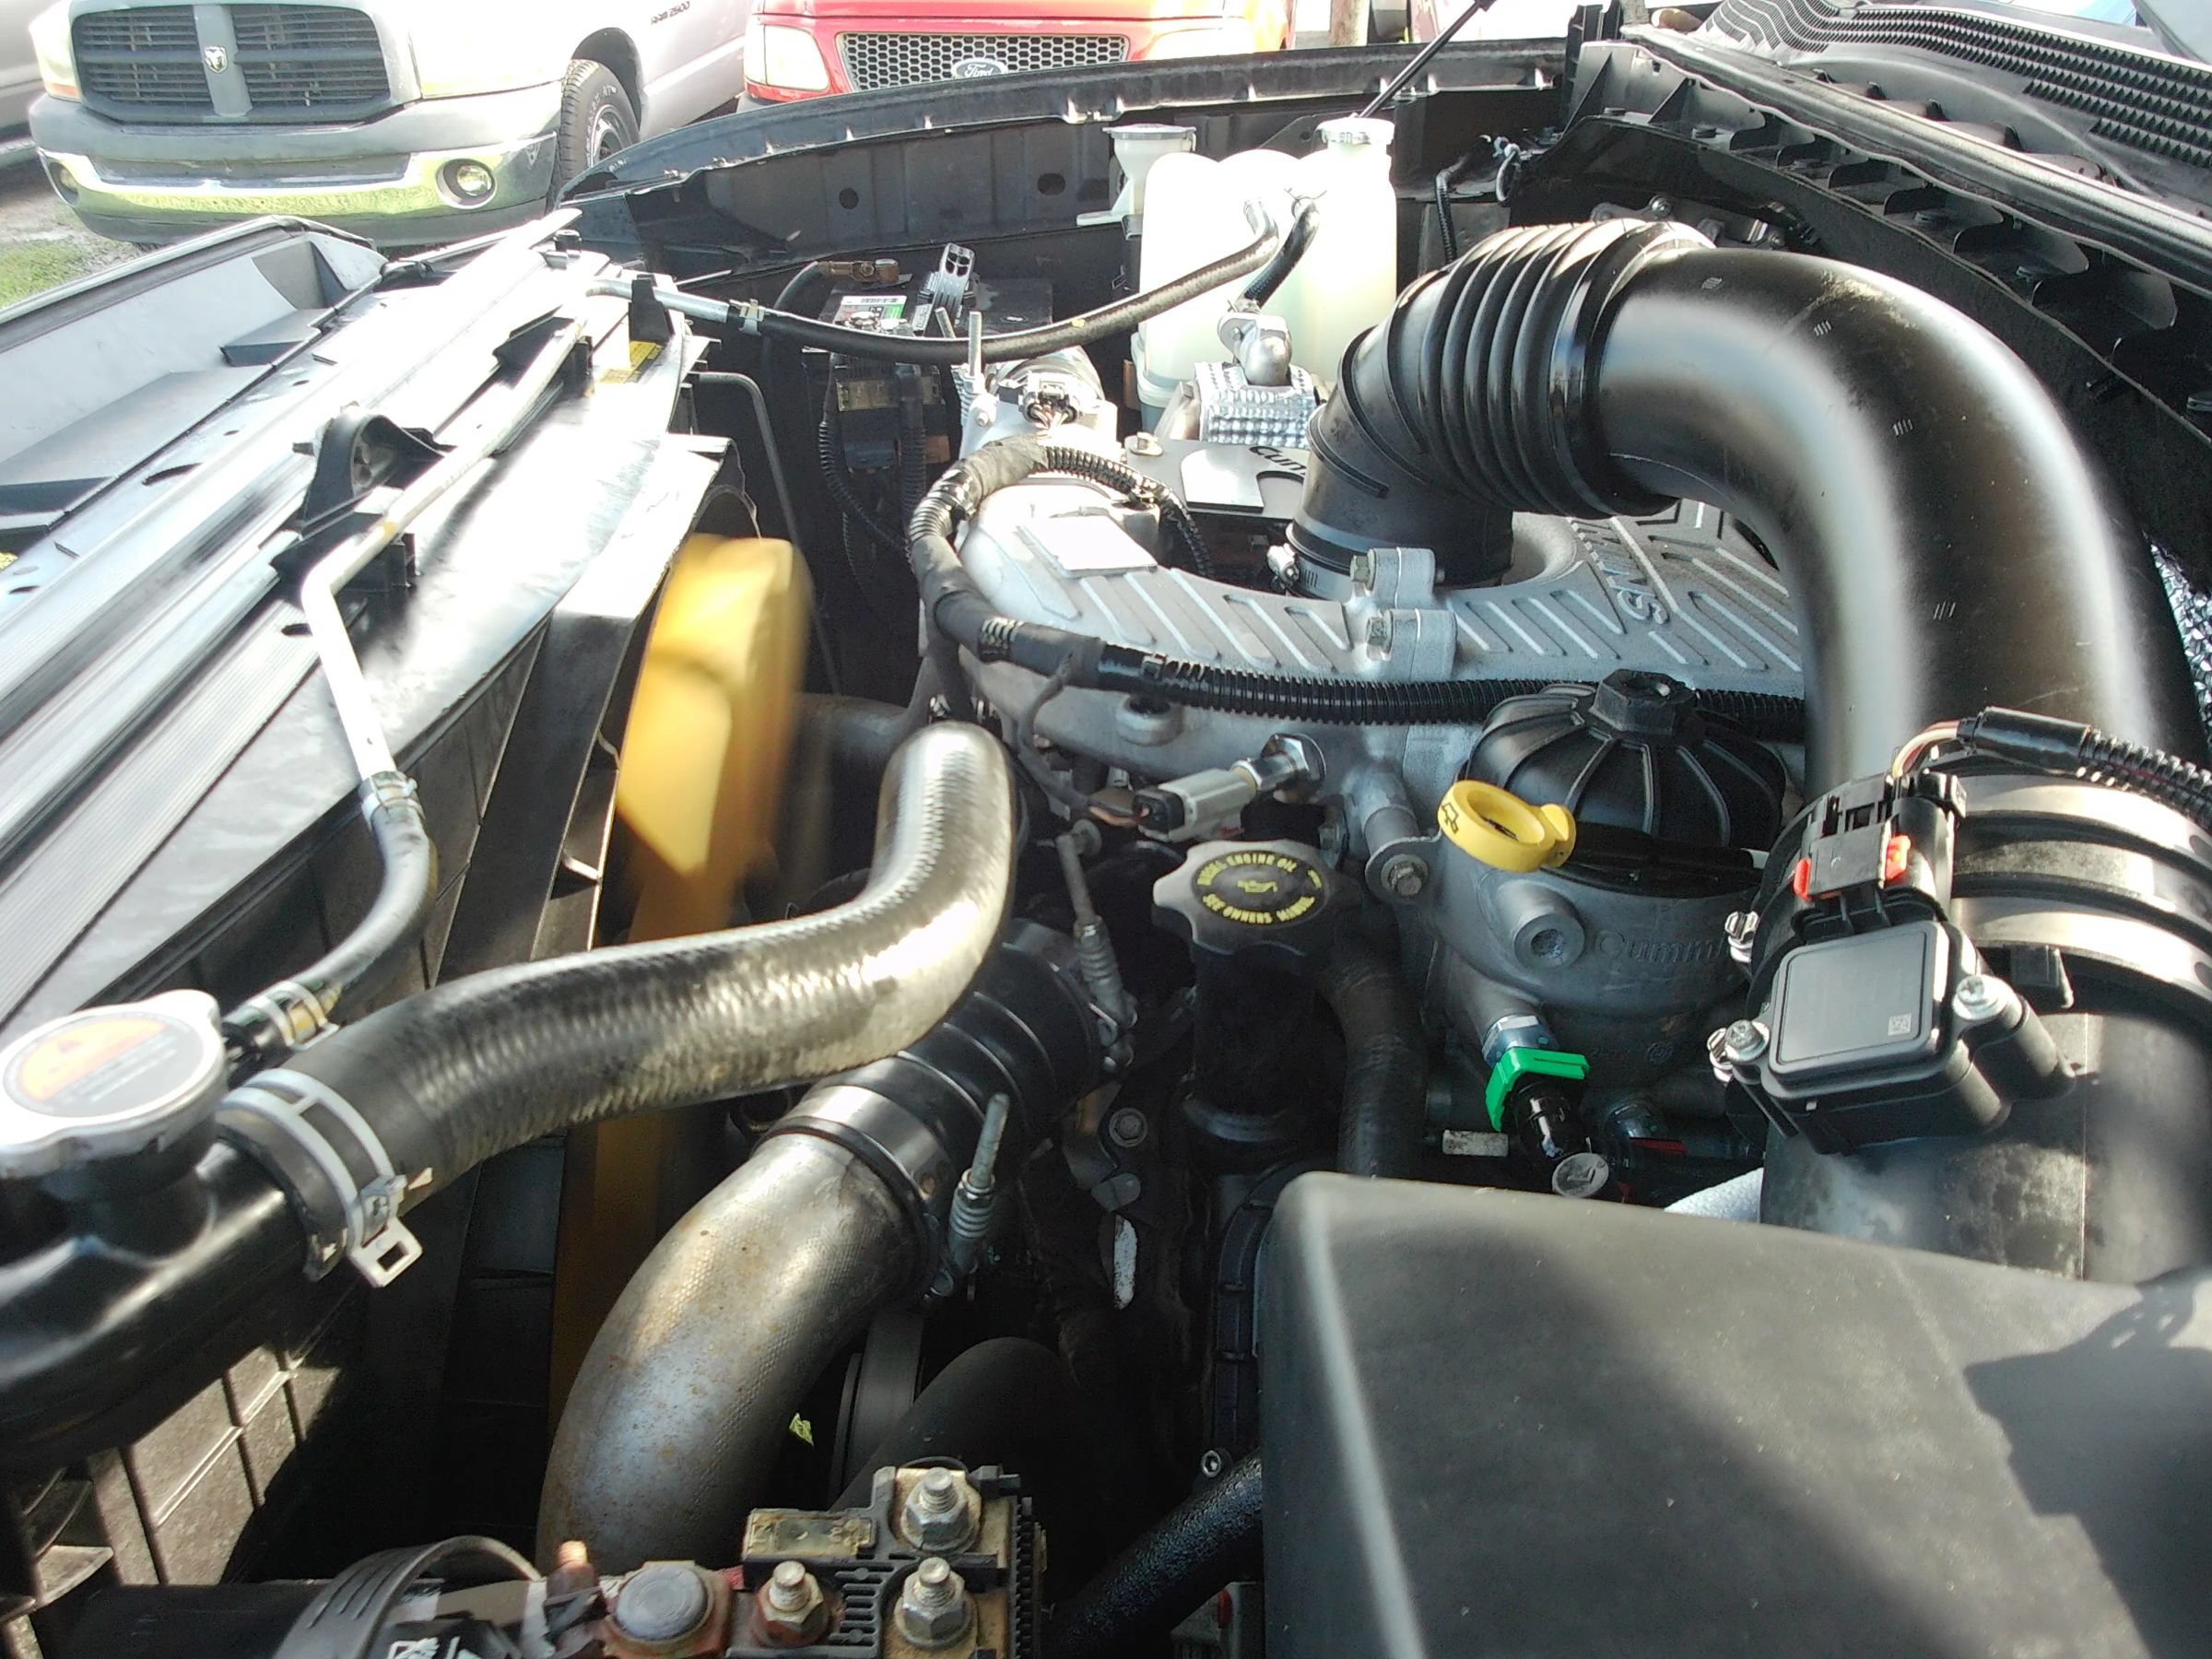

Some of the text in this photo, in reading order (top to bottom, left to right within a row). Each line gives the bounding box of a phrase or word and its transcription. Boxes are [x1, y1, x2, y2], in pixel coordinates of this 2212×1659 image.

[964, 63, 994, 78] Ford
[1226, 853, 1277, 867] ENGINE
[1277, 857, 1299, 874] OIL
[1202, 893, 1316, 925] SEE OWNERS MANUAL
[1594, 929, 1731, 963] Cummi
